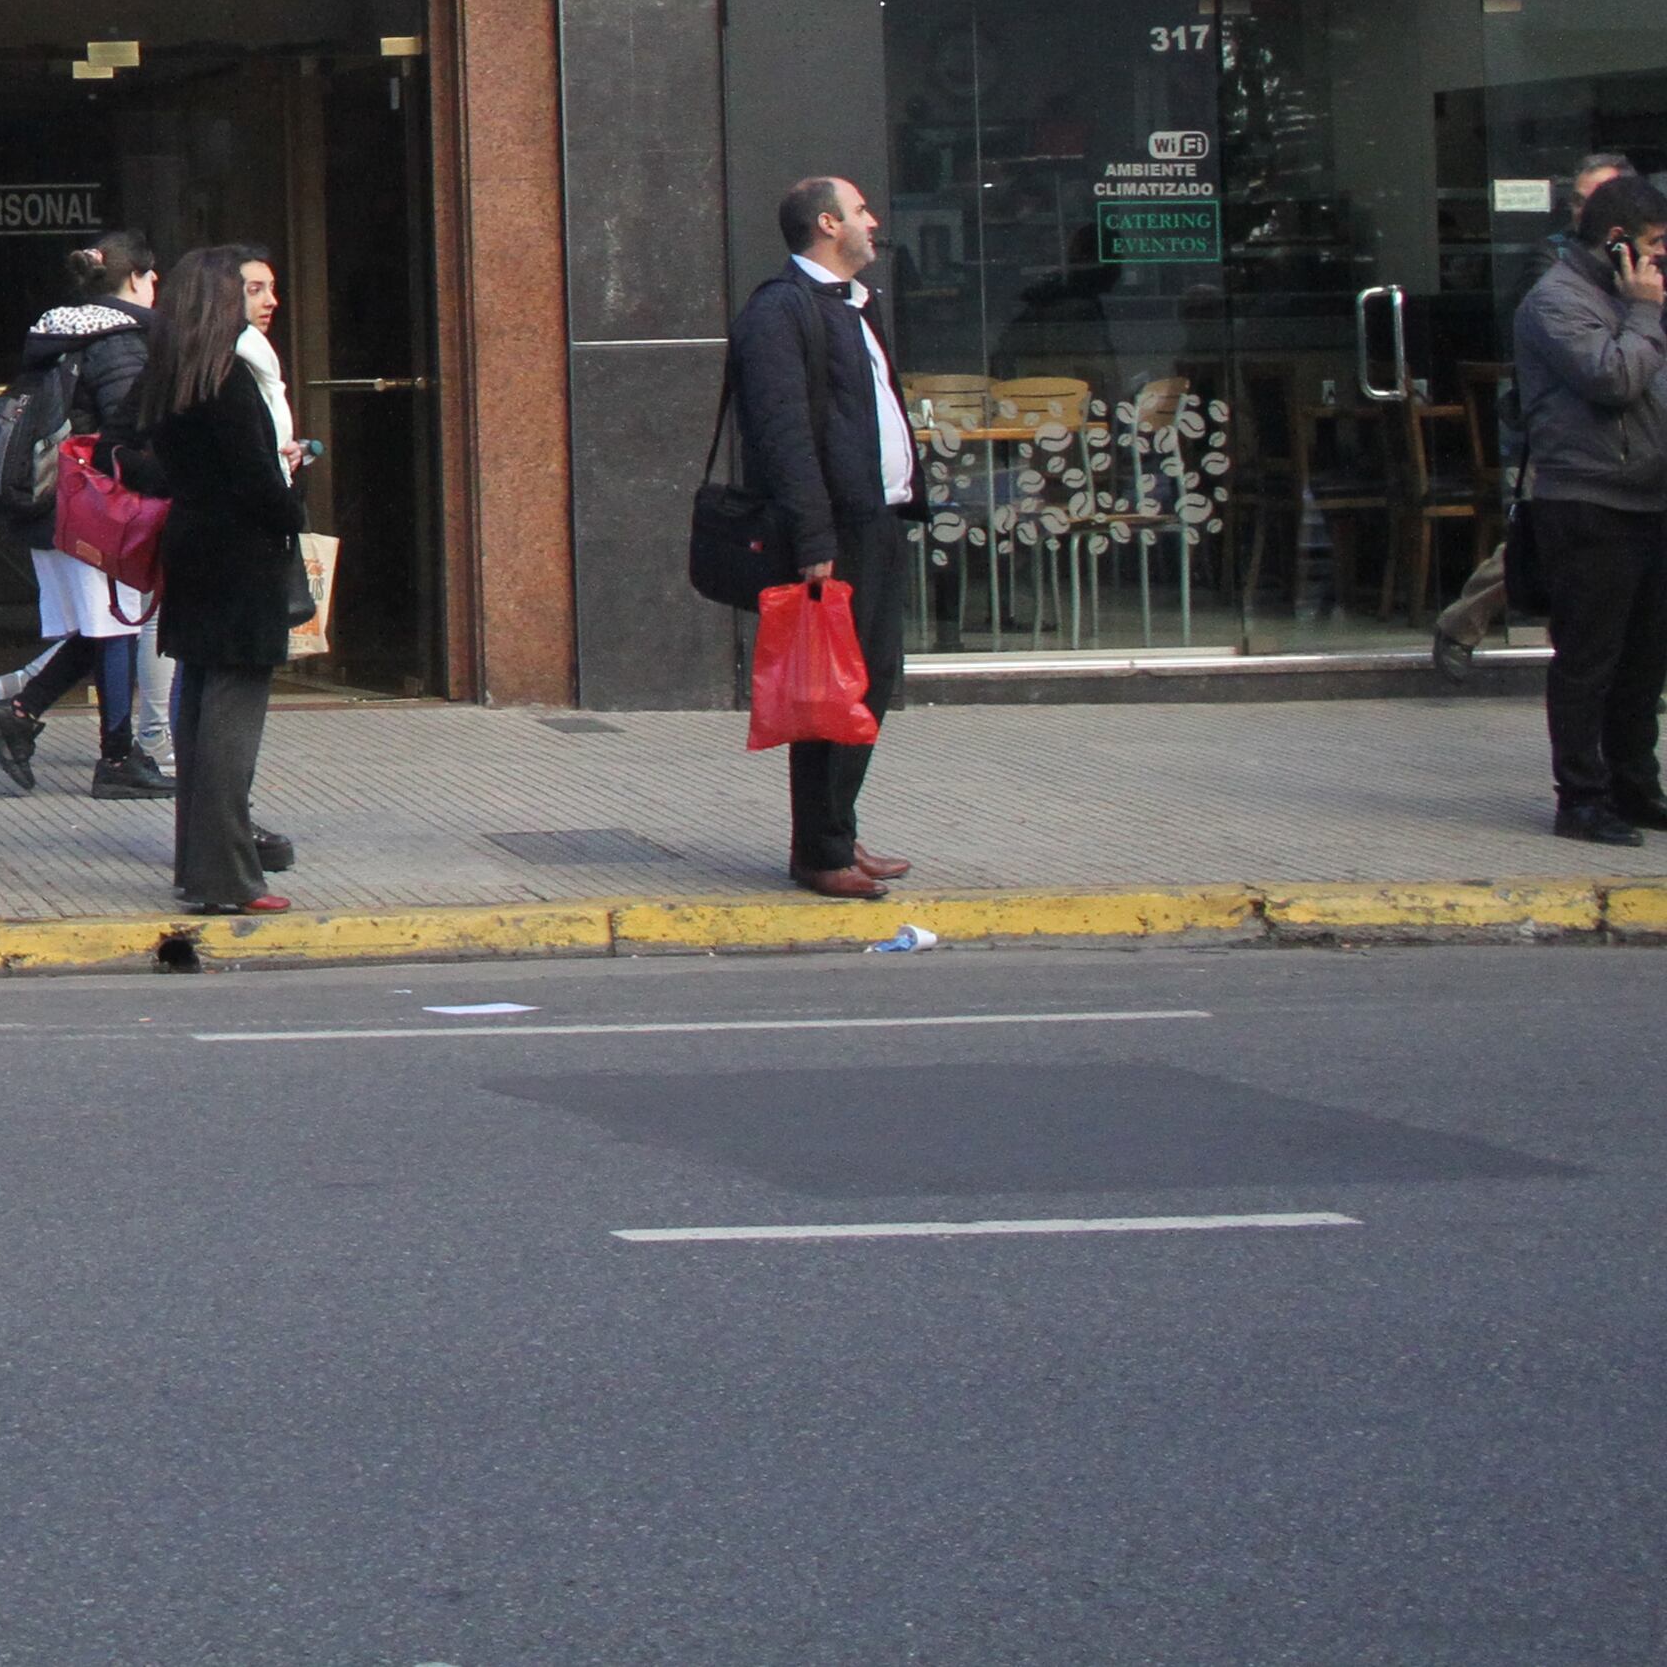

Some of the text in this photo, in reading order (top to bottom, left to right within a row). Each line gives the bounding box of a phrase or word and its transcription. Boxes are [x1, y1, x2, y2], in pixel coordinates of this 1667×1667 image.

[1149, 24, 1211, 54] 317
[1104, 163, 1198, 178] AMBIENTE
[1093, 181, 1214, 198] CLIMATIZADO
[1104, 211, 1213, 232] CATERING
[1112, 236, 1209, 255] EVENTOS
